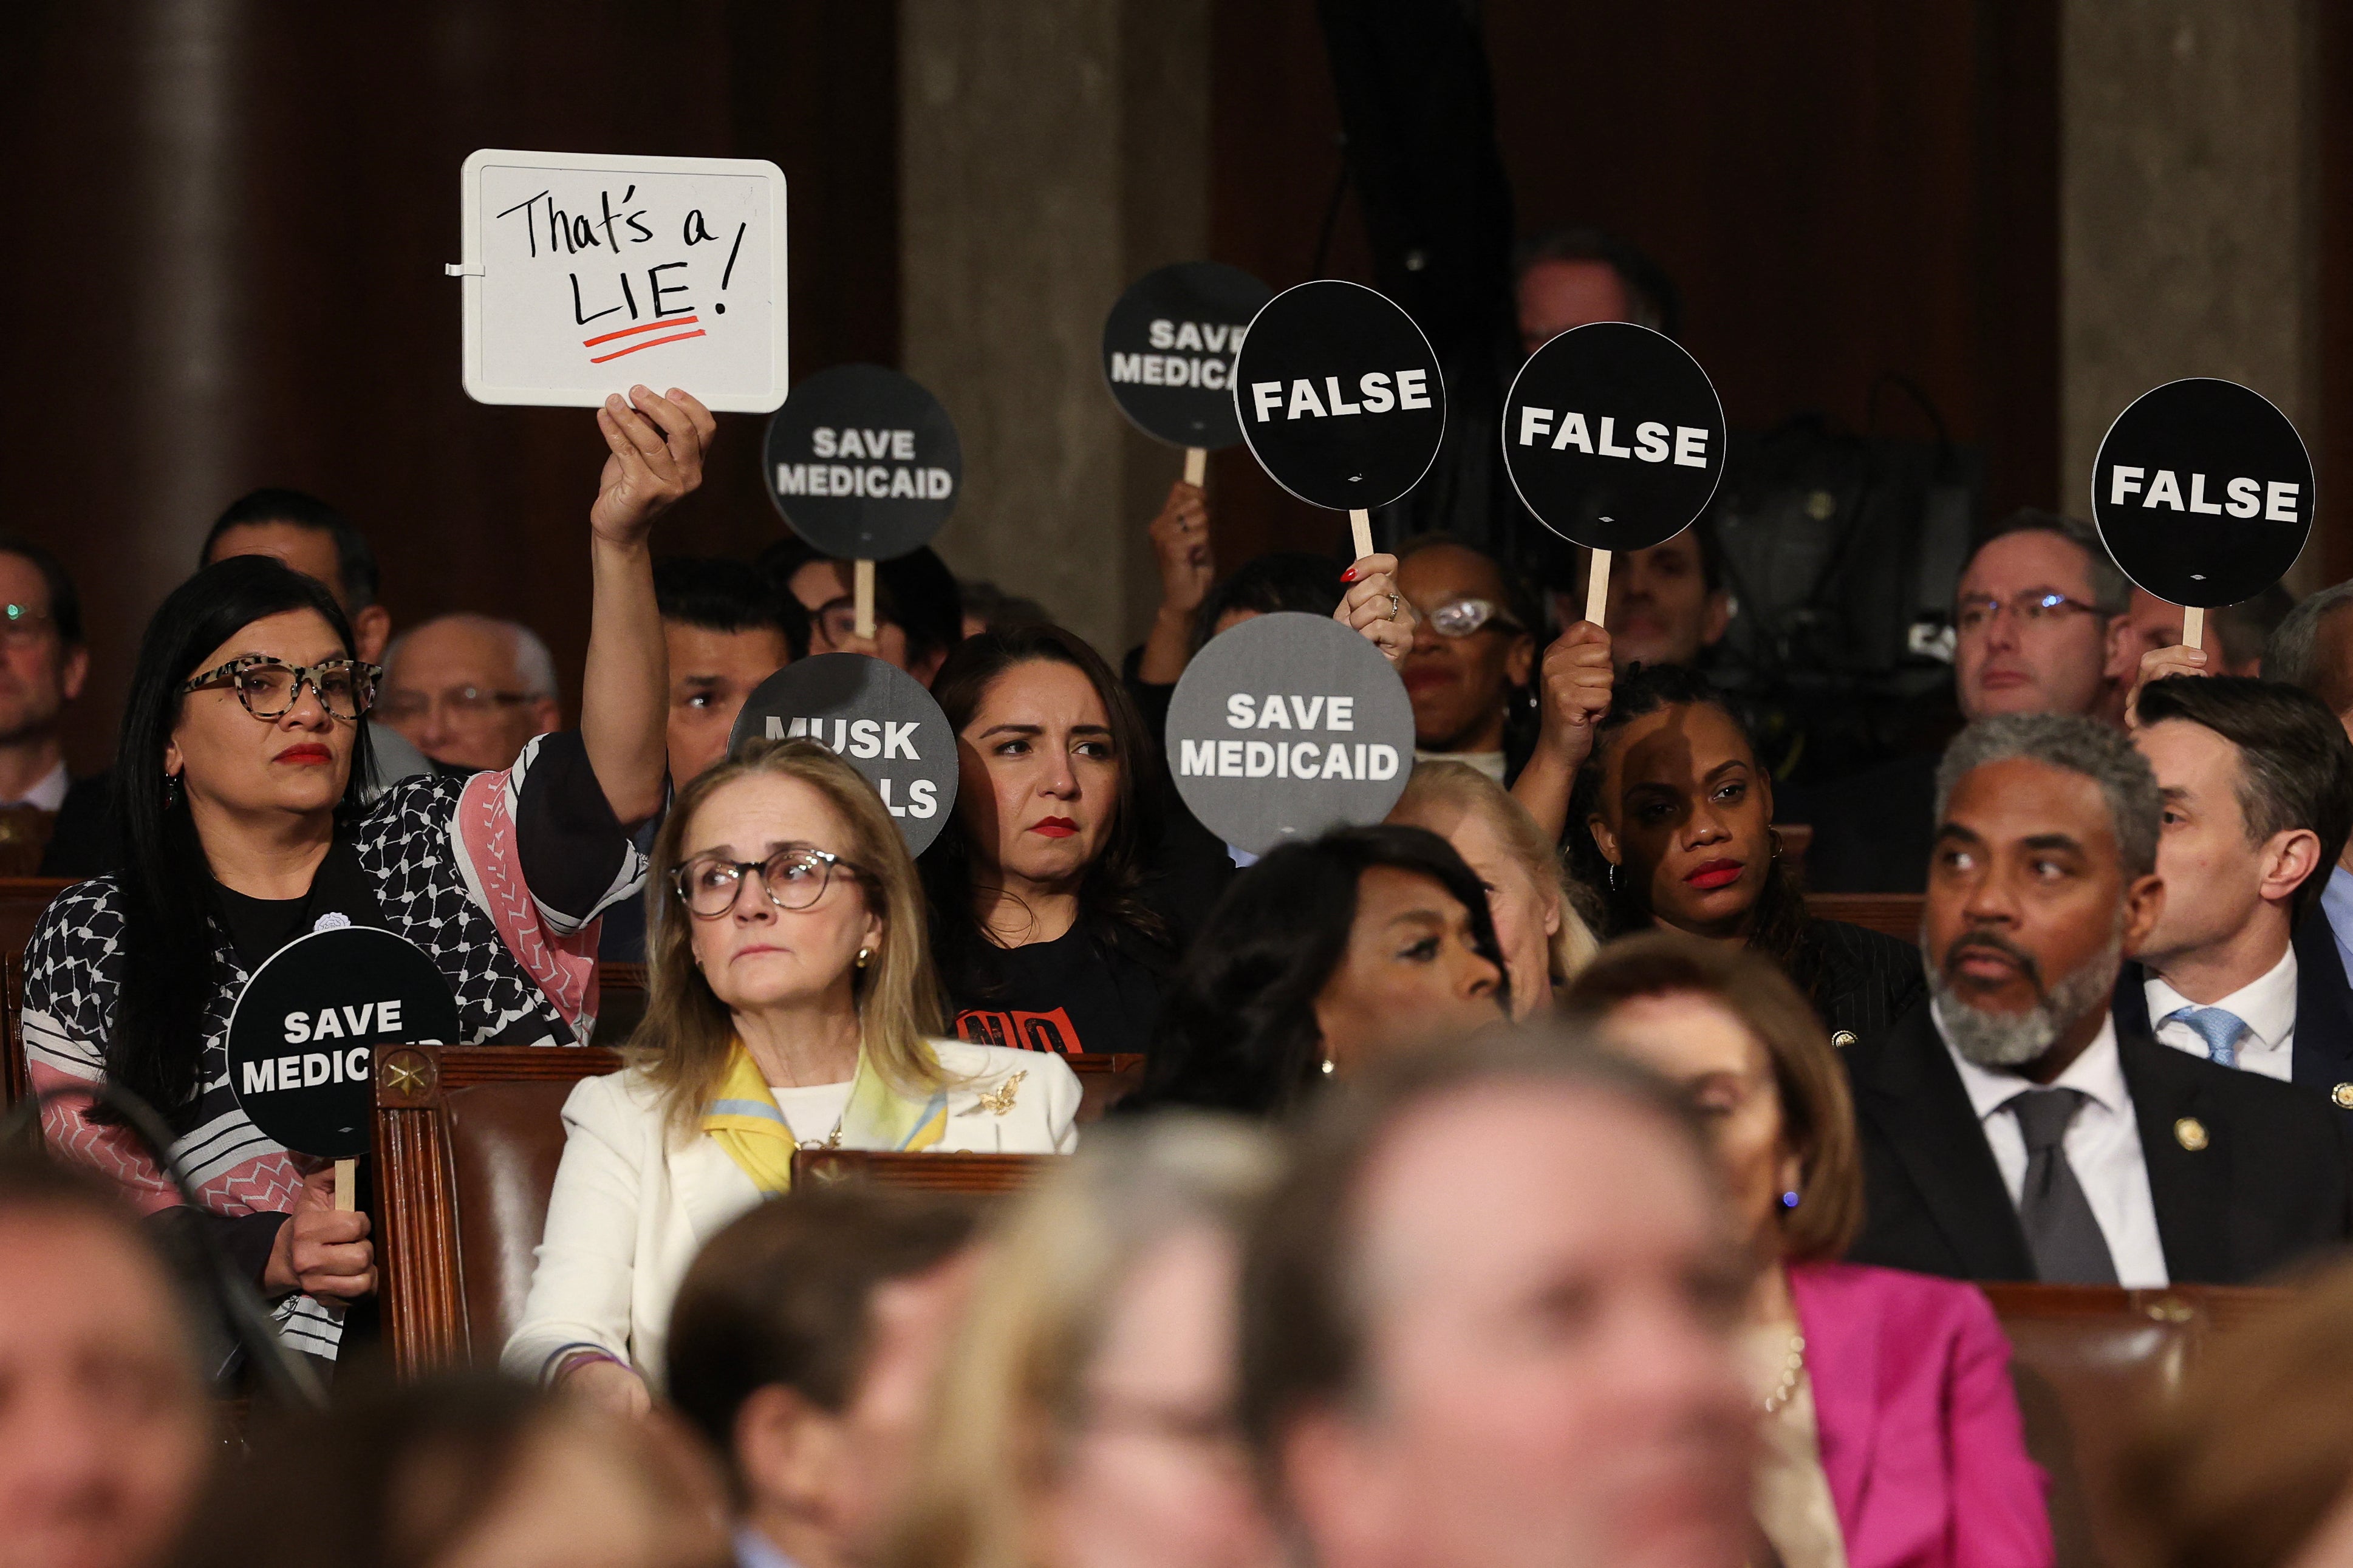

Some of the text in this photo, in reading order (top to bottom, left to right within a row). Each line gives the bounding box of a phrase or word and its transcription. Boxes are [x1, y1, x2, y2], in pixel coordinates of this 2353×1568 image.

[497, 185, 719, 257] That's a
[570, 222, 746, 325] LIE!
[1112, 351, 1235, 391] MEDIC
[1252, 369, 1432, 422] FALSE
[812, 427, 916, 460] SAVE
[1520, 406, 1709, 468] FALSE
[776, 463, 953, 500] MEDICAID
[2111, 465, 2299, 523] FALSE
[1226, 693, 1354, 731] SAVE
[1181, 739, 1399, 780] MEDICAID
[284, 1000, 402, 1044] SAVE
[243, 1039, 443, 1094] MEDIC
